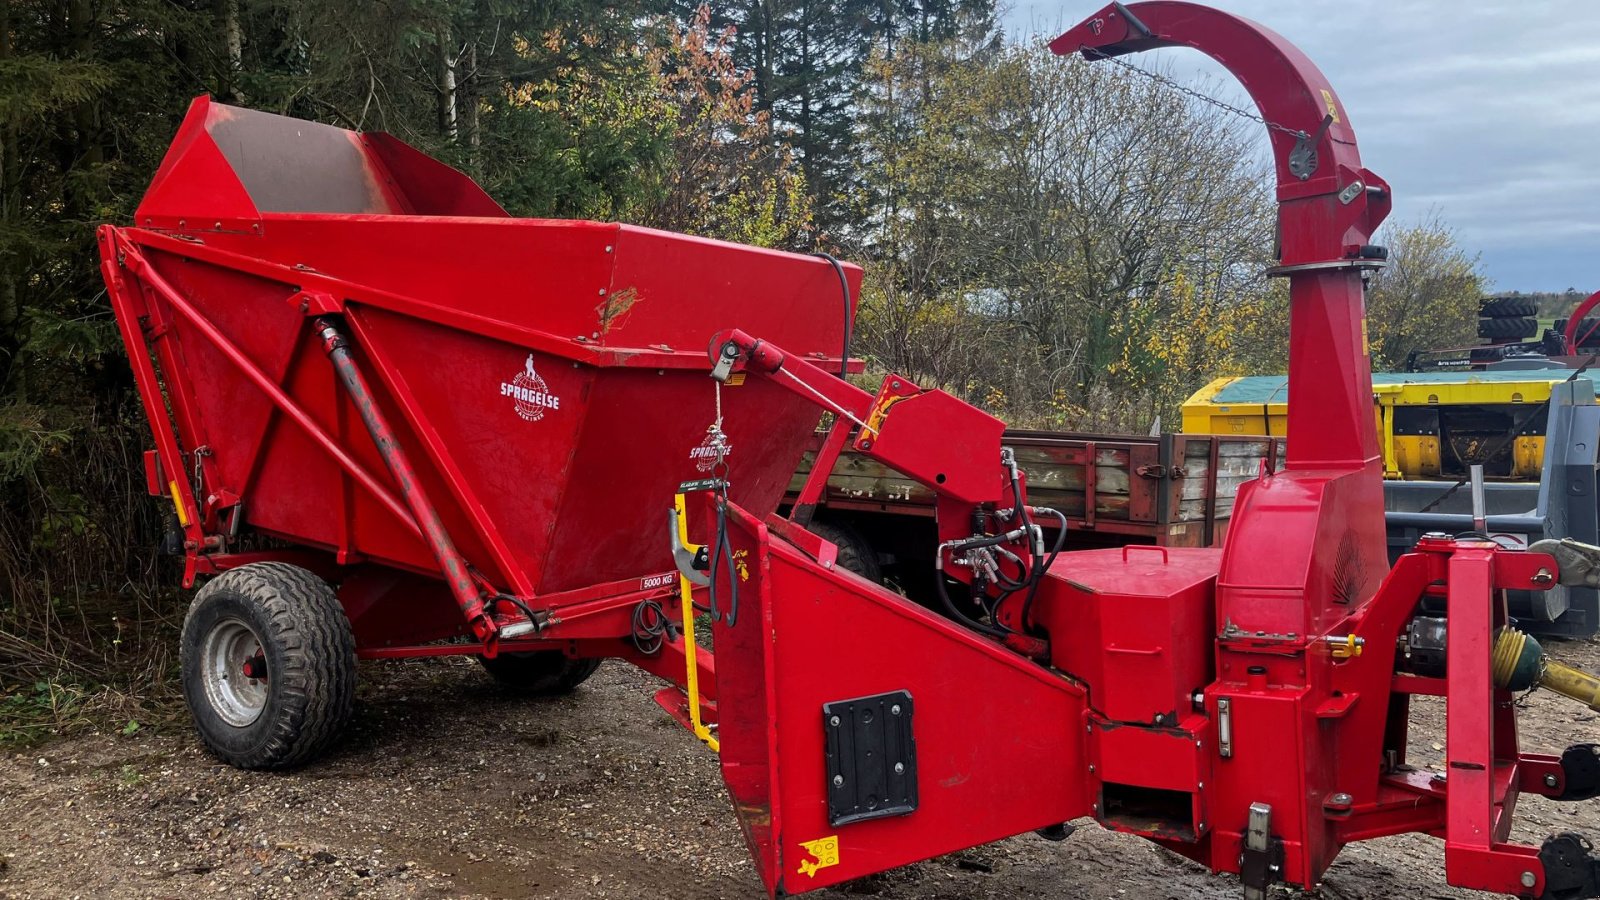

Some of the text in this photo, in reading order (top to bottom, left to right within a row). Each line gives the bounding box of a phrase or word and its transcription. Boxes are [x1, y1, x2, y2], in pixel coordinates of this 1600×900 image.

[501, 382, 559, 410] SPRAGELSE
[644, 575, 672, 588] 5000 KG
